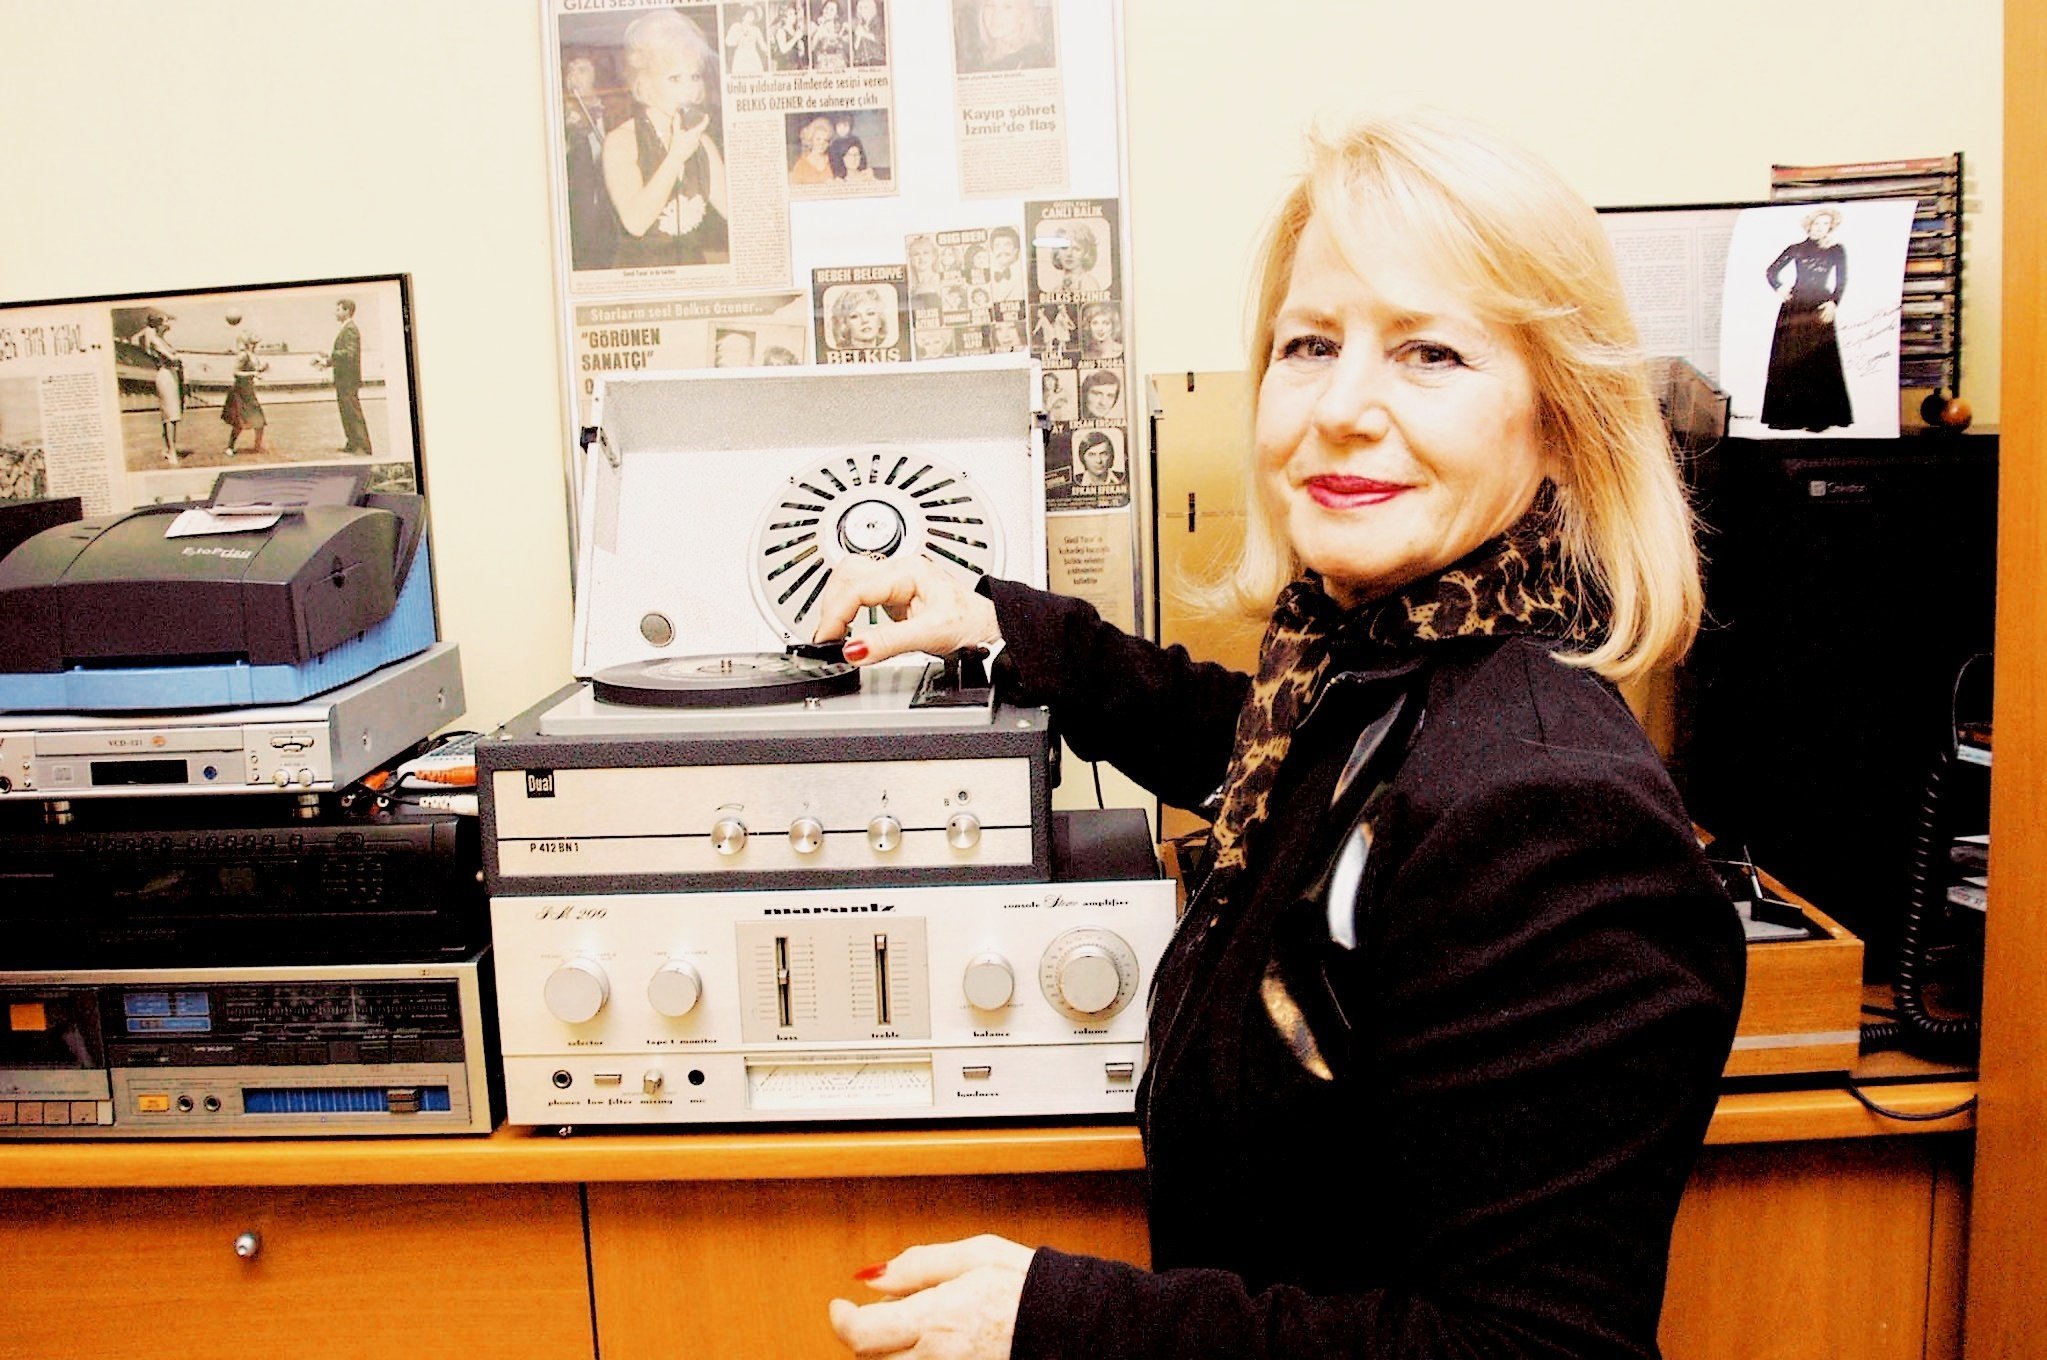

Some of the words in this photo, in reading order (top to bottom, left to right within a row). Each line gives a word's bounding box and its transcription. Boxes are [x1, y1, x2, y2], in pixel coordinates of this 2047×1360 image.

[963, 107, 1005, 122] Kayıp
[1009, 103, 1057, 120] şöhret
[1029, 118, 1056, 133] flaş
[528, 774, 553, 792] Dual
[764, 903, 896, 915] marantz
[872, 1031, 899, 1039] treble
